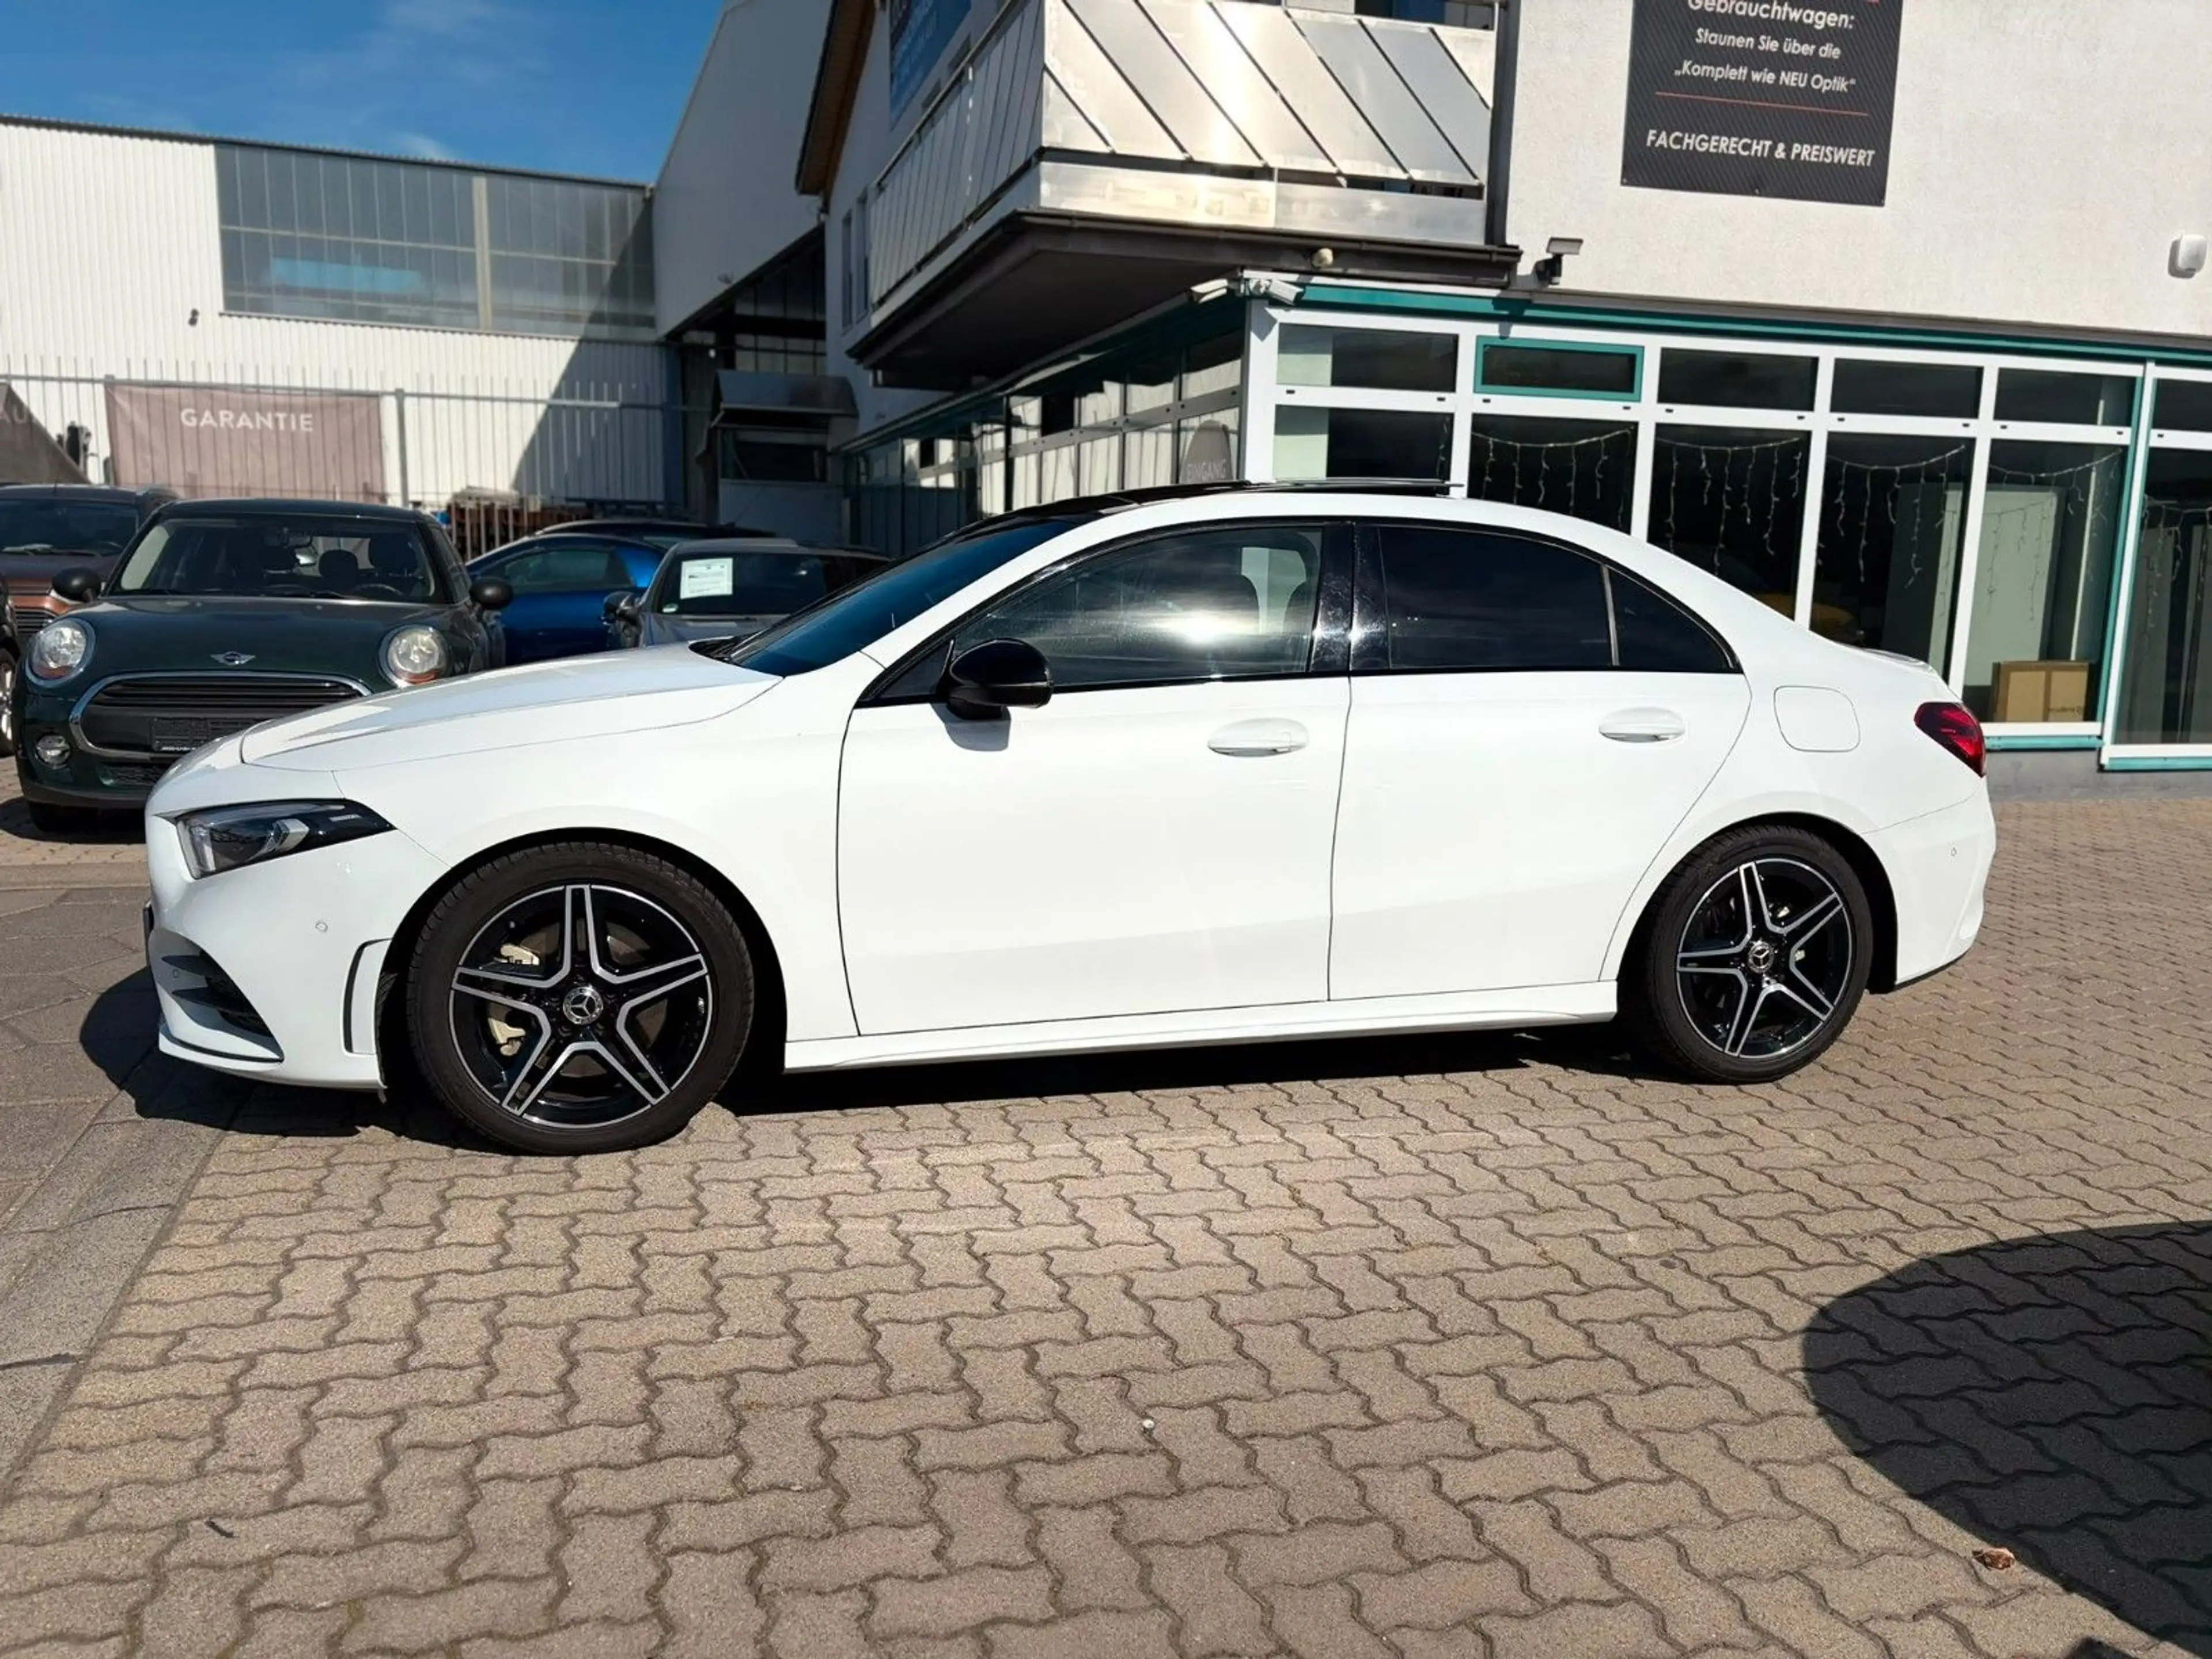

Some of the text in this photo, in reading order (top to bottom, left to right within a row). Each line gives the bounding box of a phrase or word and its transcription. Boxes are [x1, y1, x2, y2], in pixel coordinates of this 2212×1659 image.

[1687, 0, 1855, 29] Gebrauchtwagen:
[1695, 28, 1841, 59] Staunen Sie über die
[1751, 67, 1776, 84] wie
[1779, 70, 1808, 87] NEU
[1646, 129, 1876, 167] FACHGERECHT & PREISWERT
[180, 408, 314, 432] GARANTIE
